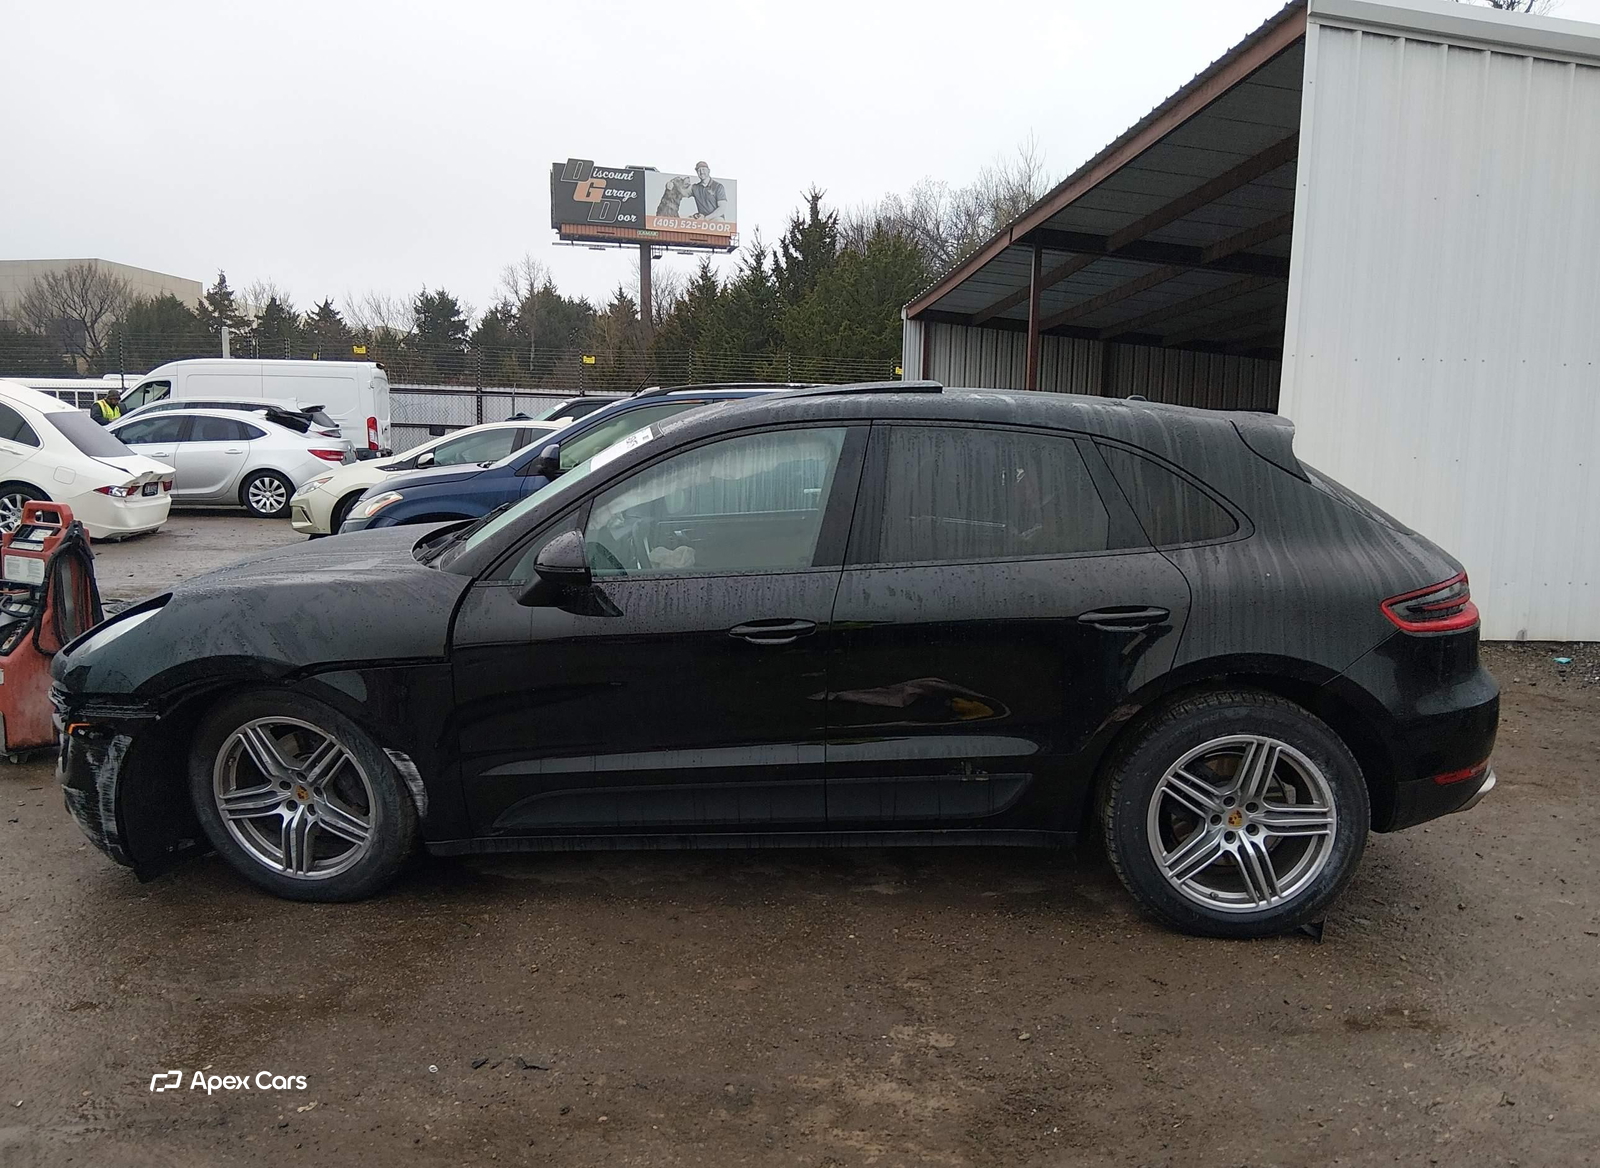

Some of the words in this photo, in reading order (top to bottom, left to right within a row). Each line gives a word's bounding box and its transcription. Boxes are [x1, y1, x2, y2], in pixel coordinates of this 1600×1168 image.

[561, 158, 635, 182] Discount
[573, 178, 638, 203] Garage
[587, 198, 637, 223] Door
[653, 217, 678, 229] (405)
[680, 219, 731, 233] 525-DOOR
